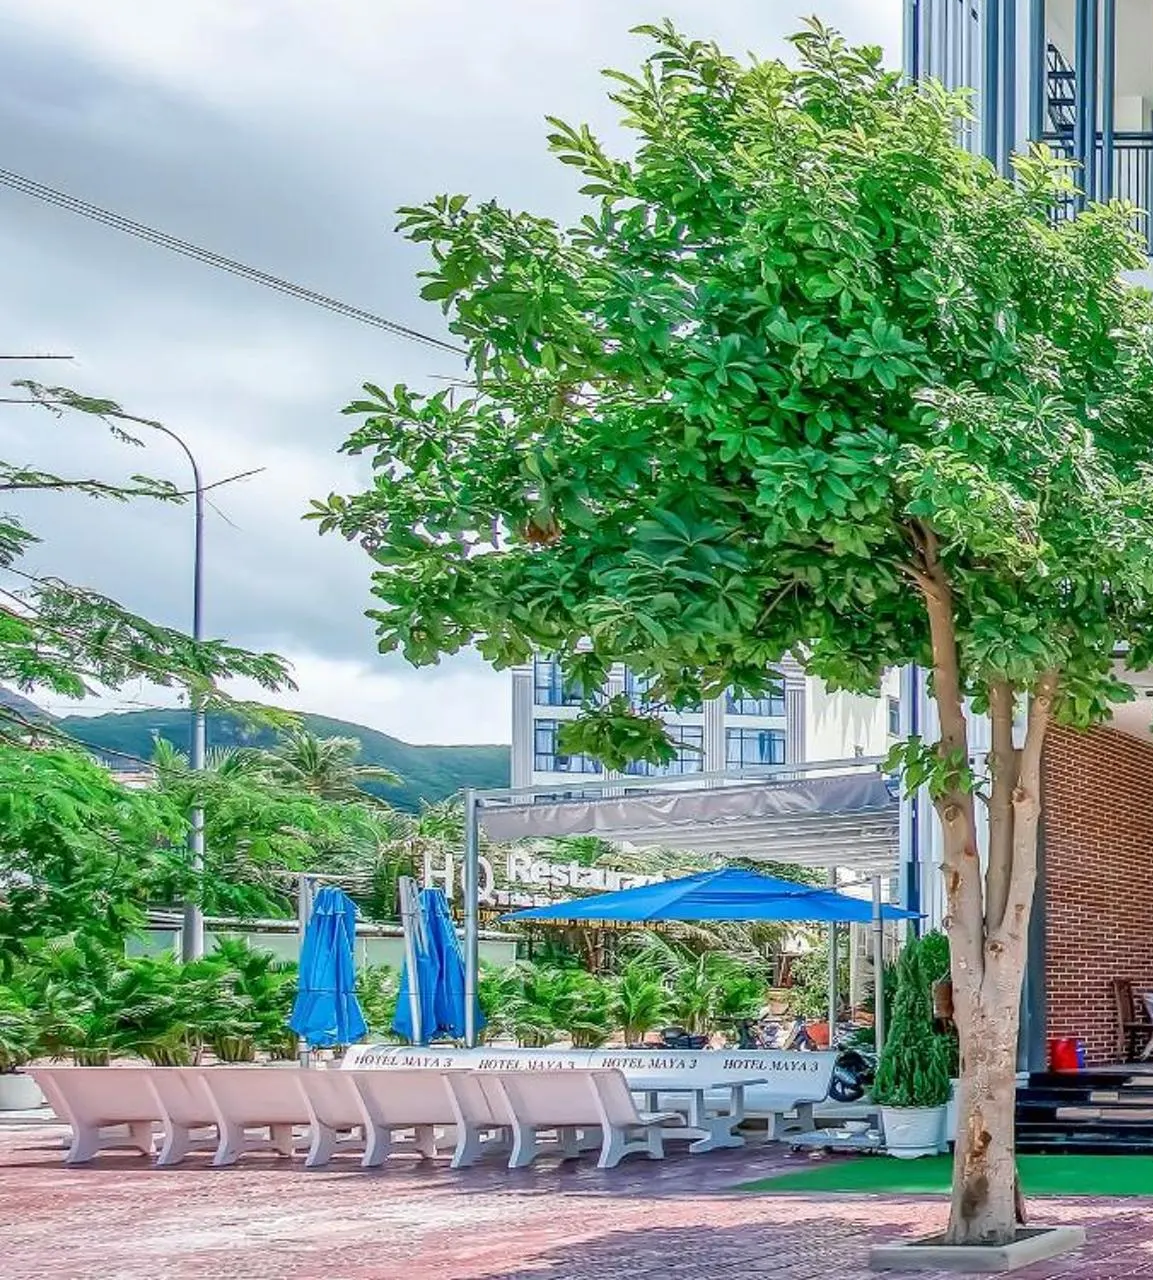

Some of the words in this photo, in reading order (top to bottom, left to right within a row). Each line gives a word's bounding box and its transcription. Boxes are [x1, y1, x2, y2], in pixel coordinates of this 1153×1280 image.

[354, 1055, 400, 1067] HOTEL
[402, 1056, 440, 1068] MAYA
[442, 1057, 454, 1068] 3
[478, 1059, 523, 1070] HOTEL
[602, 1057, 645, 1068] HOTEL
[648, 1058, 686, 1069] MAYA
[688, 1058, 698, 1069] 3
[723, 1058, 768, 1070] HOTEL
[769, 1060, 808, 1071] MAYA
[810, 1061, 820, 1072] 3
